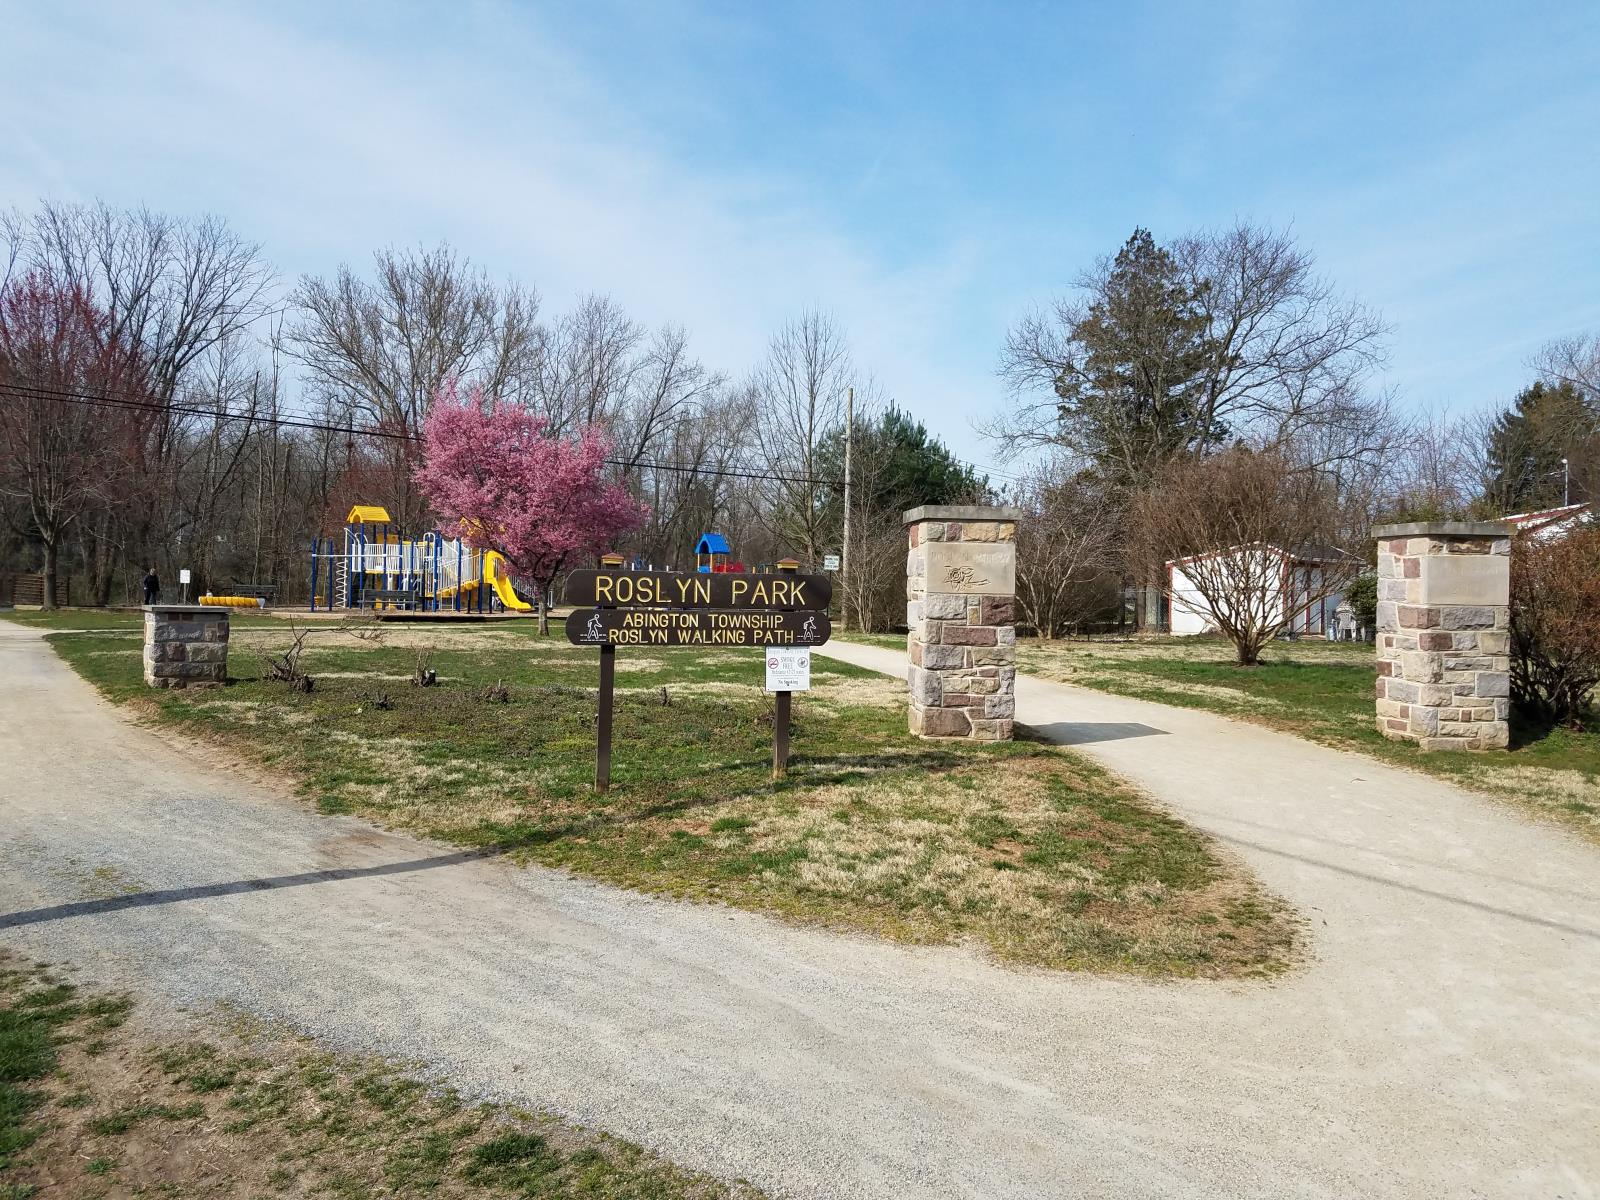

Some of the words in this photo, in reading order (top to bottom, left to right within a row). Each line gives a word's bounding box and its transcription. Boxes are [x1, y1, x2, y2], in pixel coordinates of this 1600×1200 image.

[595, 575, 711, 604] ROSLYN
[731, 580, 806, 606] PARK
[623, 613, 699, 628] ABINGTON
[708, 614, 784, 629] TOWNSHIP
[608, 629, 668, 644] ROSLYN
[677, 629, 745, 644] WALKING
[754, 630, 794, 644] PATH
